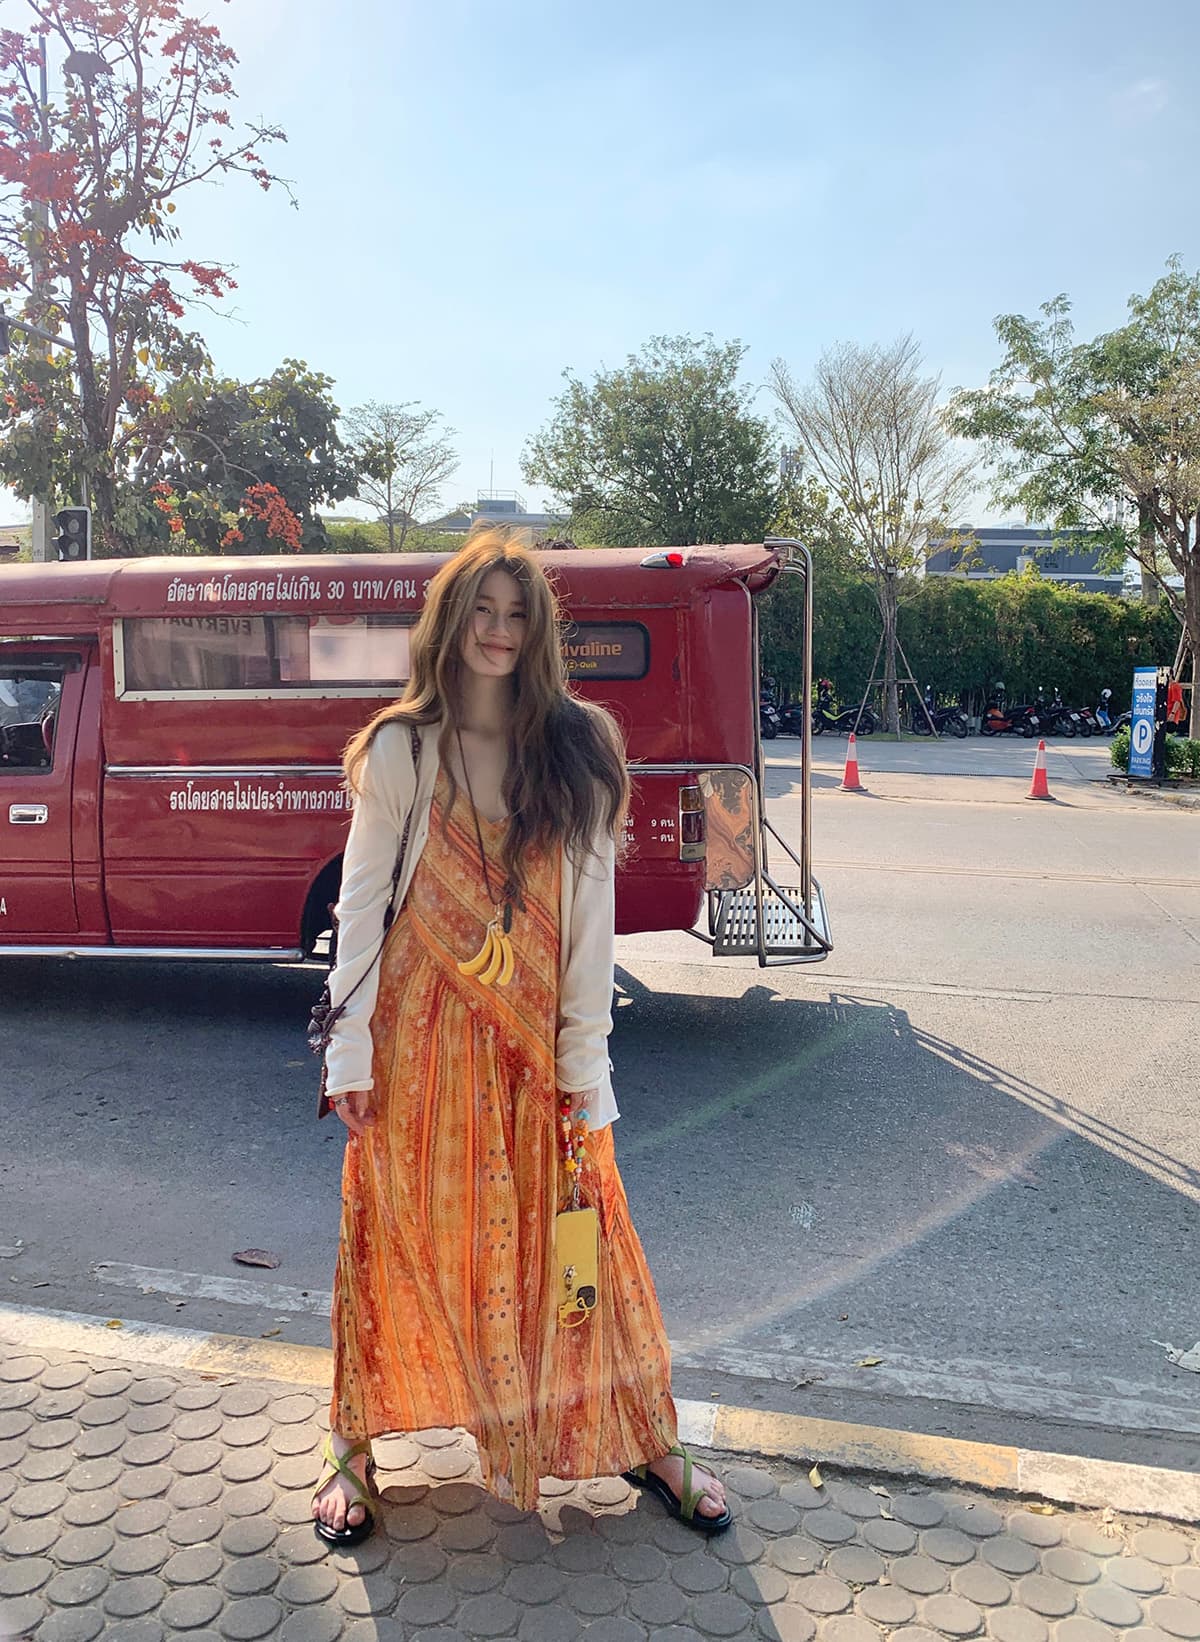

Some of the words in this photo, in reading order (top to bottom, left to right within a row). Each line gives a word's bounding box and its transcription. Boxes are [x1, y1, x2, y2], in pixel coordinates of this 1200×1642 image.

[167, 573, 321, 602] อัตราค่าโดยสารไม่เกิน
[327, 580, 345, 600] 30
[352, 578, 417, 601] บาท/คน
[1138, 725, 1148, 749] P
[660, 818, 675, 828] คน
[660, 833, 675, 842] คน
